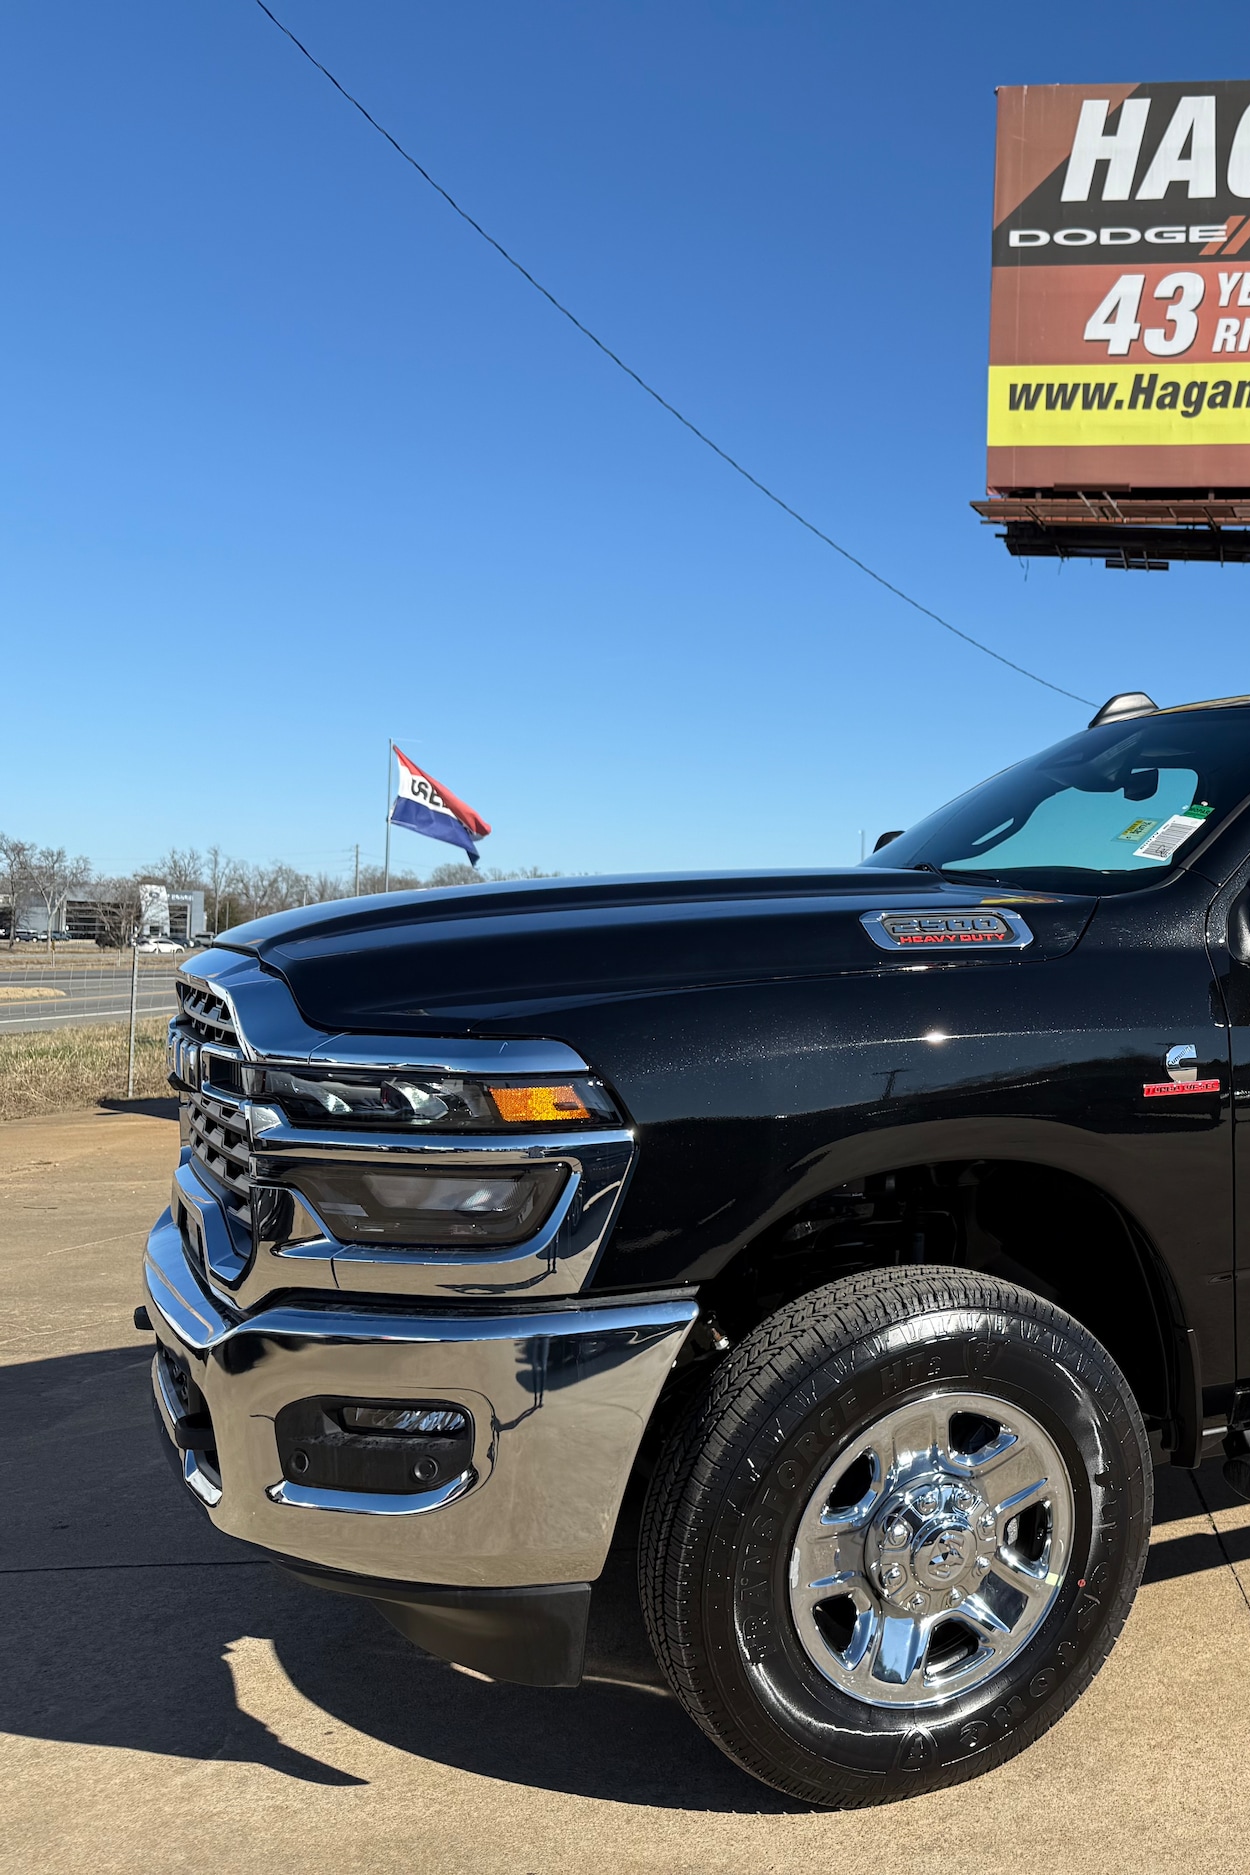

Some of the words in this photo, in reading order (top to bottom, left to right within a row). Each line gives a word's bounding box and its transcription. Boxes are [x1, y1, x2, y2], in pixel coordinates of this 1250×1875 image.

[1009, 225, 1227, 247] DODGE
[1083, 271, 1206, 356] 43
[899, 934, 956, 944] HEAVY
[960, 933, 1005, 942] DUTY
[739, 1388, 860, 1662] TRANSFORCE
